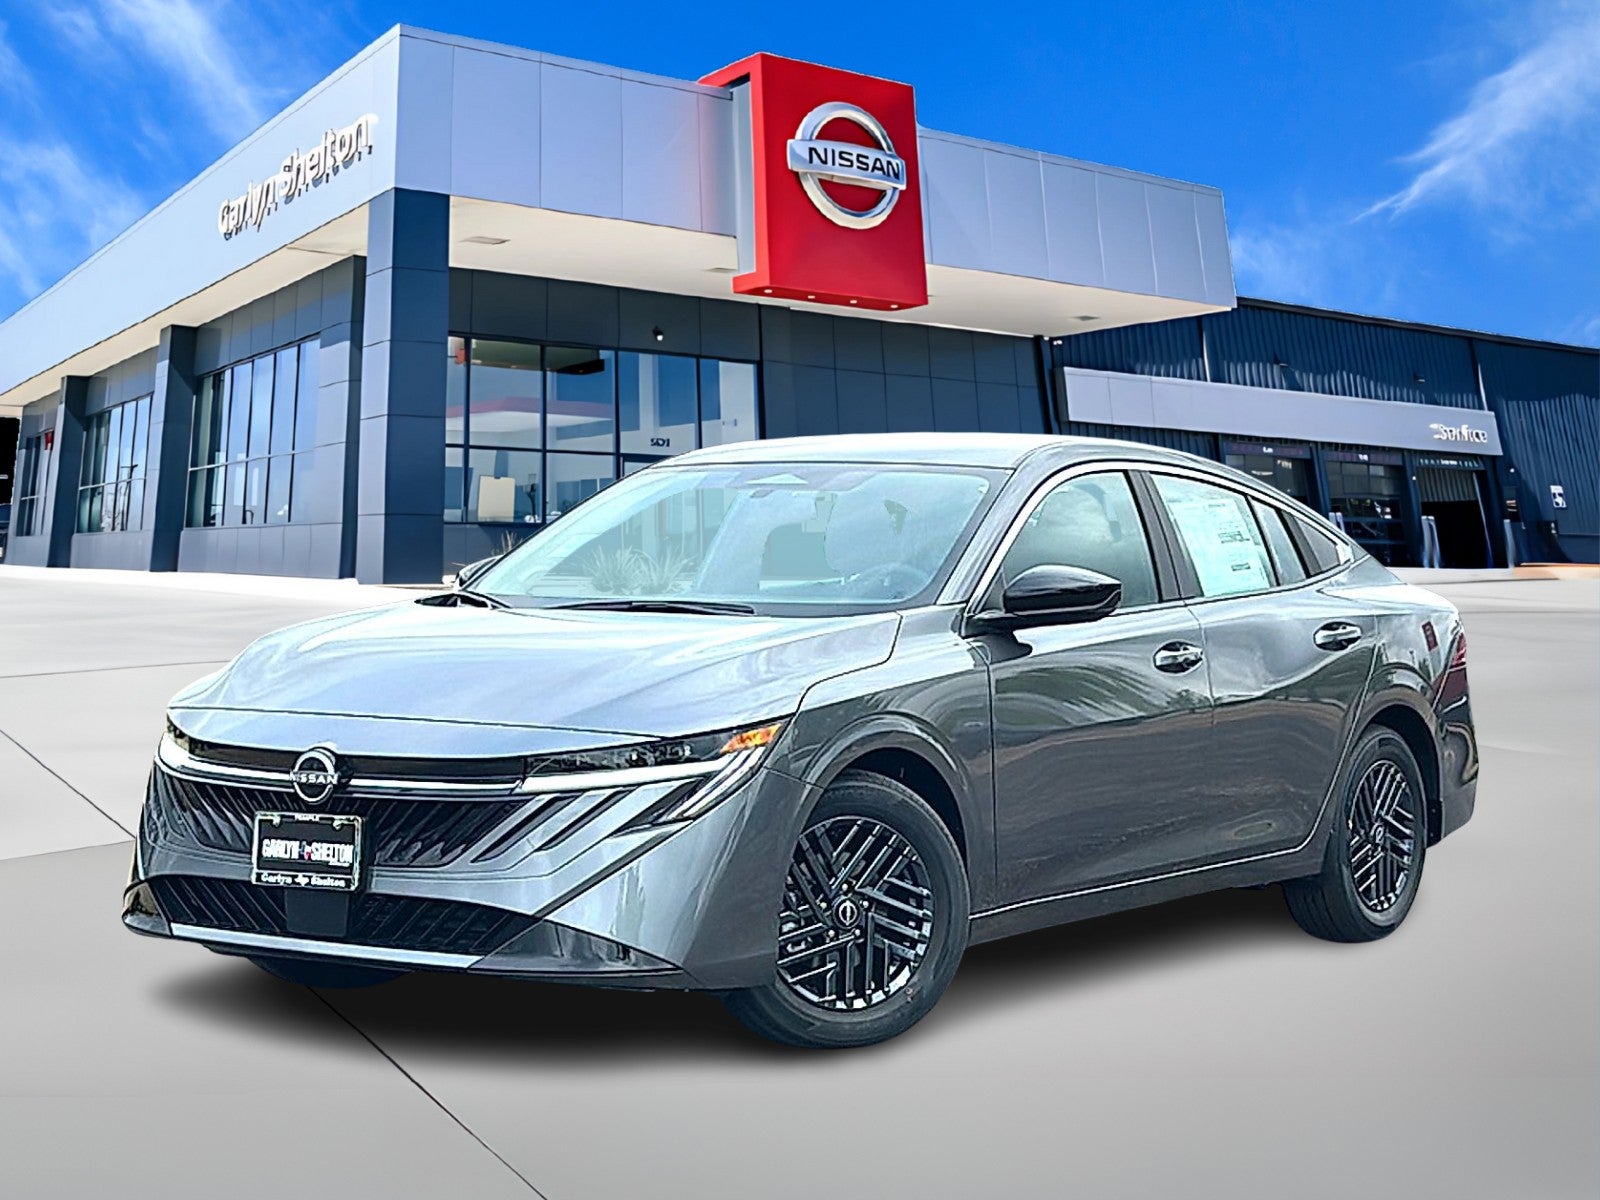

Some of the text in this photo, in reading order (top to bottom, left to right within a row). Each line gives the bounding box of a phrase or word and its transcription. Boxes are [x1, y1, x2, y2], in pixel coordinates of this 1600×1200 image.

[218, 115, 375, 238] Garlyn Shelton
[808, 146, 900, 181] NISSAN
[289, 769, 338, 785] NISSAN
[261, 838, 354, 864] GARLYN SHELTON
